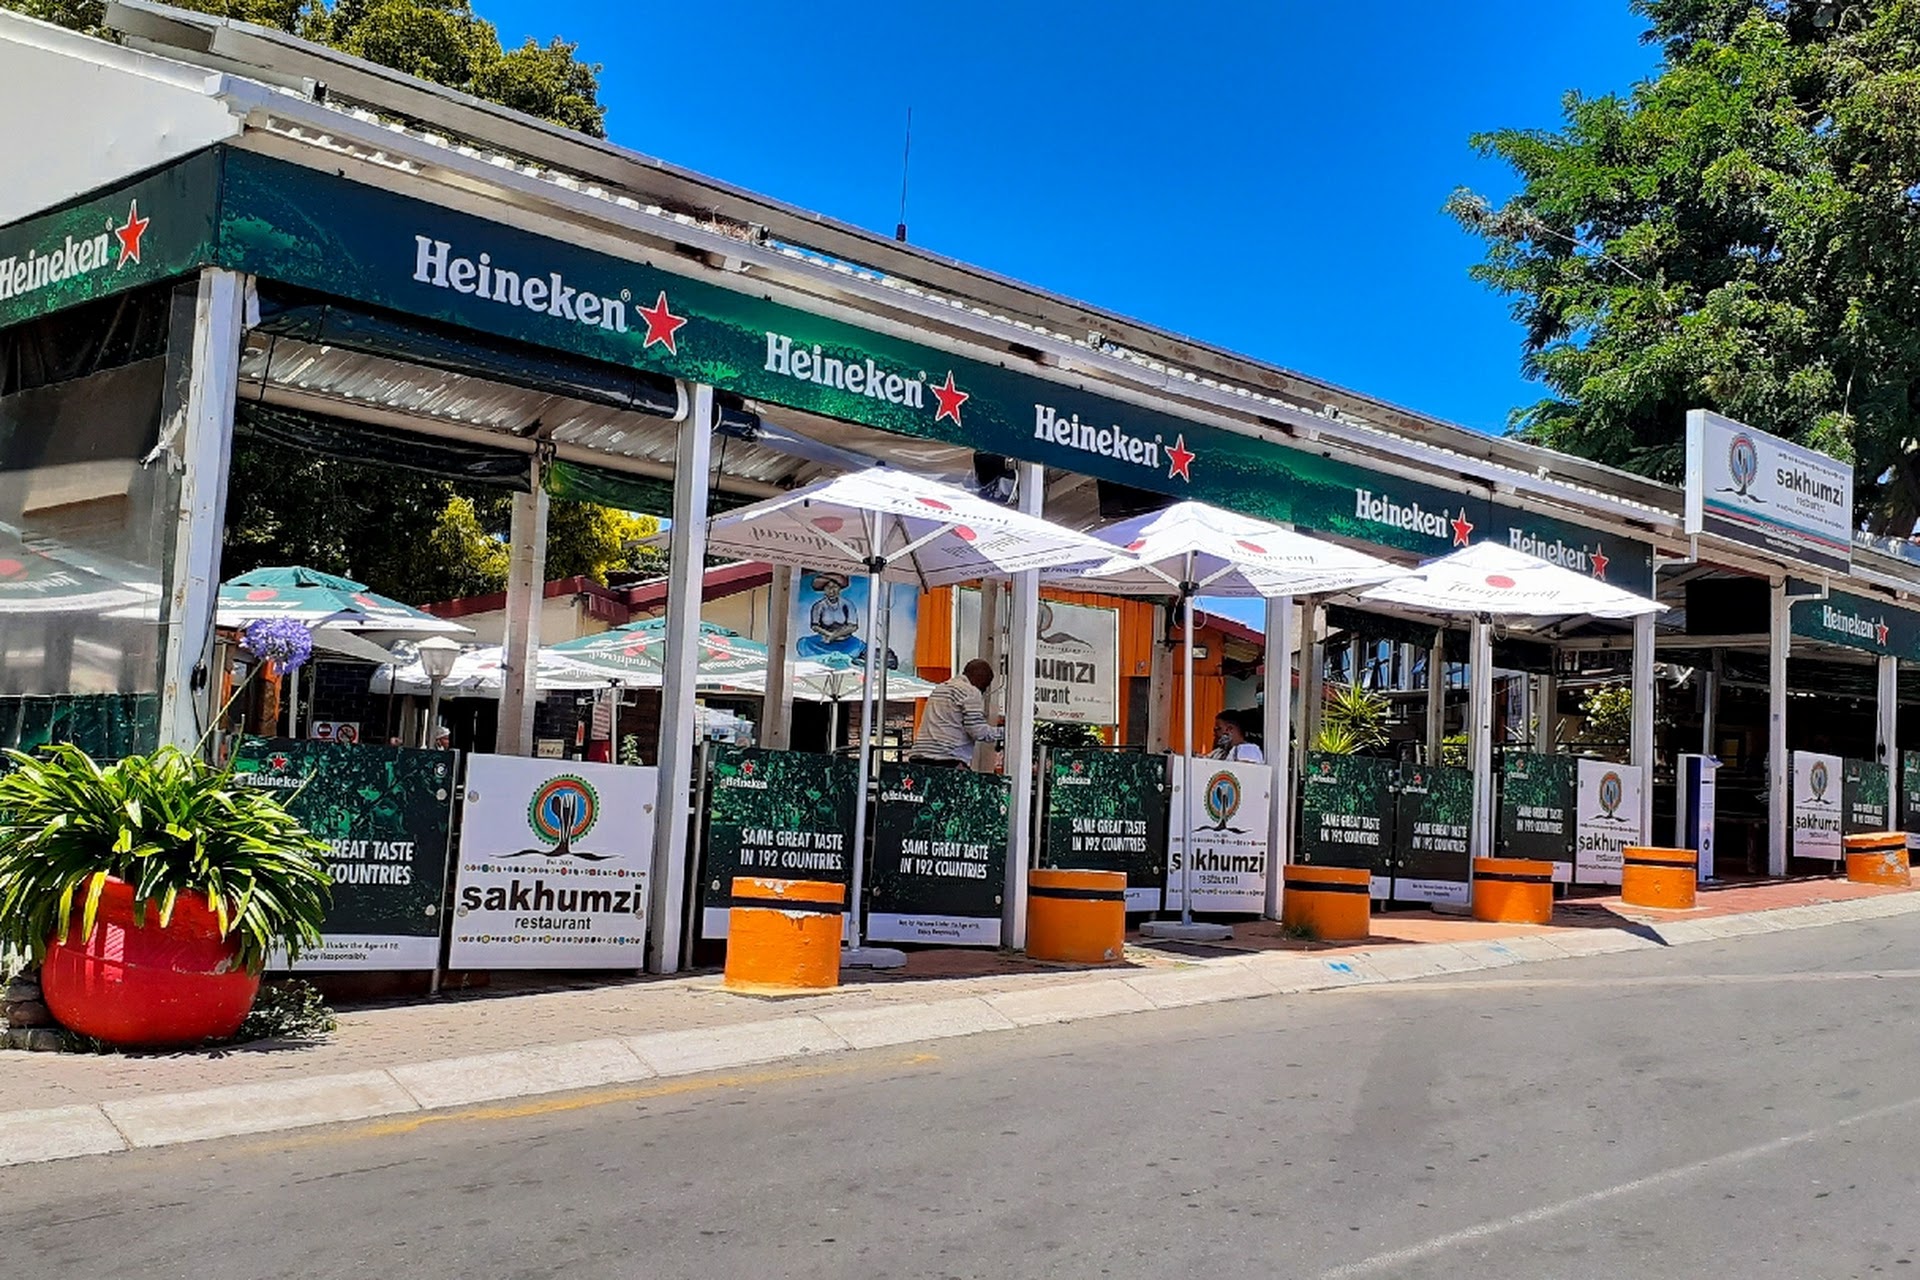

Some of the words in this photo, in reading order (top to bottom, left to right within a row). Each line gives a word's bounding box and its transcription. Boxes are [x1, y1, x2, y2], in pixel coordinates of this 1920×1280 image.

[0, 233, 109, 299] Heineken
[413, 235, 628, 333] Heineken
[764, 332, 924, 410] Heineken
[1034, 404, 1160, 468] Heineken
[1776, 466, 1844, 508] sakhumzi
[1355, 488, 1448, 538] Heineken
[1508, 526, 1588, 571] Heineken
[1823, 605, 1874, 639] Heineken
[1072, 819, 1095, 834] SAME
[1097, 820, 1123, 834] GREAT
[1125, 821, 1147, 835] TASTE
[1321, 813, 1340, 828] SAME
[1340, 814, 1361, 829] GREAT
[1362, 816, 1381, 830] TASTE
[1413, 822, 1430, 836] SAME
[1431, 823, 1450, 837] GREAT
[1450, 824, 1467, 838] TASTE
[1795, 813, 1840, 831] sakhumzi
[742, 828, 773, 846] SAME
[776, 830, 811, 848] GREAT
[813, 832, 844, 850] TASTE
[1072, 836, 1082, 851] IN
[1085, 836, 1099, 851] 192
[1101, 838, 1147, 852] COUNTRIES
[1320, 827, 1329, 842] IN
[1331, 828, 1343, 843] 192
[1344, 830, 1380, 845] COUNTRIES
[1422, 836, 1433, 850] 192
[1434, 837, 1466, 852] COUNTRIES
[372, 841, 415, 862] TASTE
[740, 849, 754, 865] IN
[758, 849, 778, 866] 192
[781, 851, 842, 870] COUNTRIES
[902, 838, 929, 856] SAME
[931, 841, 961, 858] GREAT
[963, 843, 989, 860] TASTE
[326, 863, 412, 885] COUNTRIES
[900, 857, 911, 874] IN
[915, 859, 933, 876] 192
[935, 860, 987, 879] COUNTRIES
[460, 880, 642, 914] sakhumzi
[514, 915, 592, 931] restaurant
